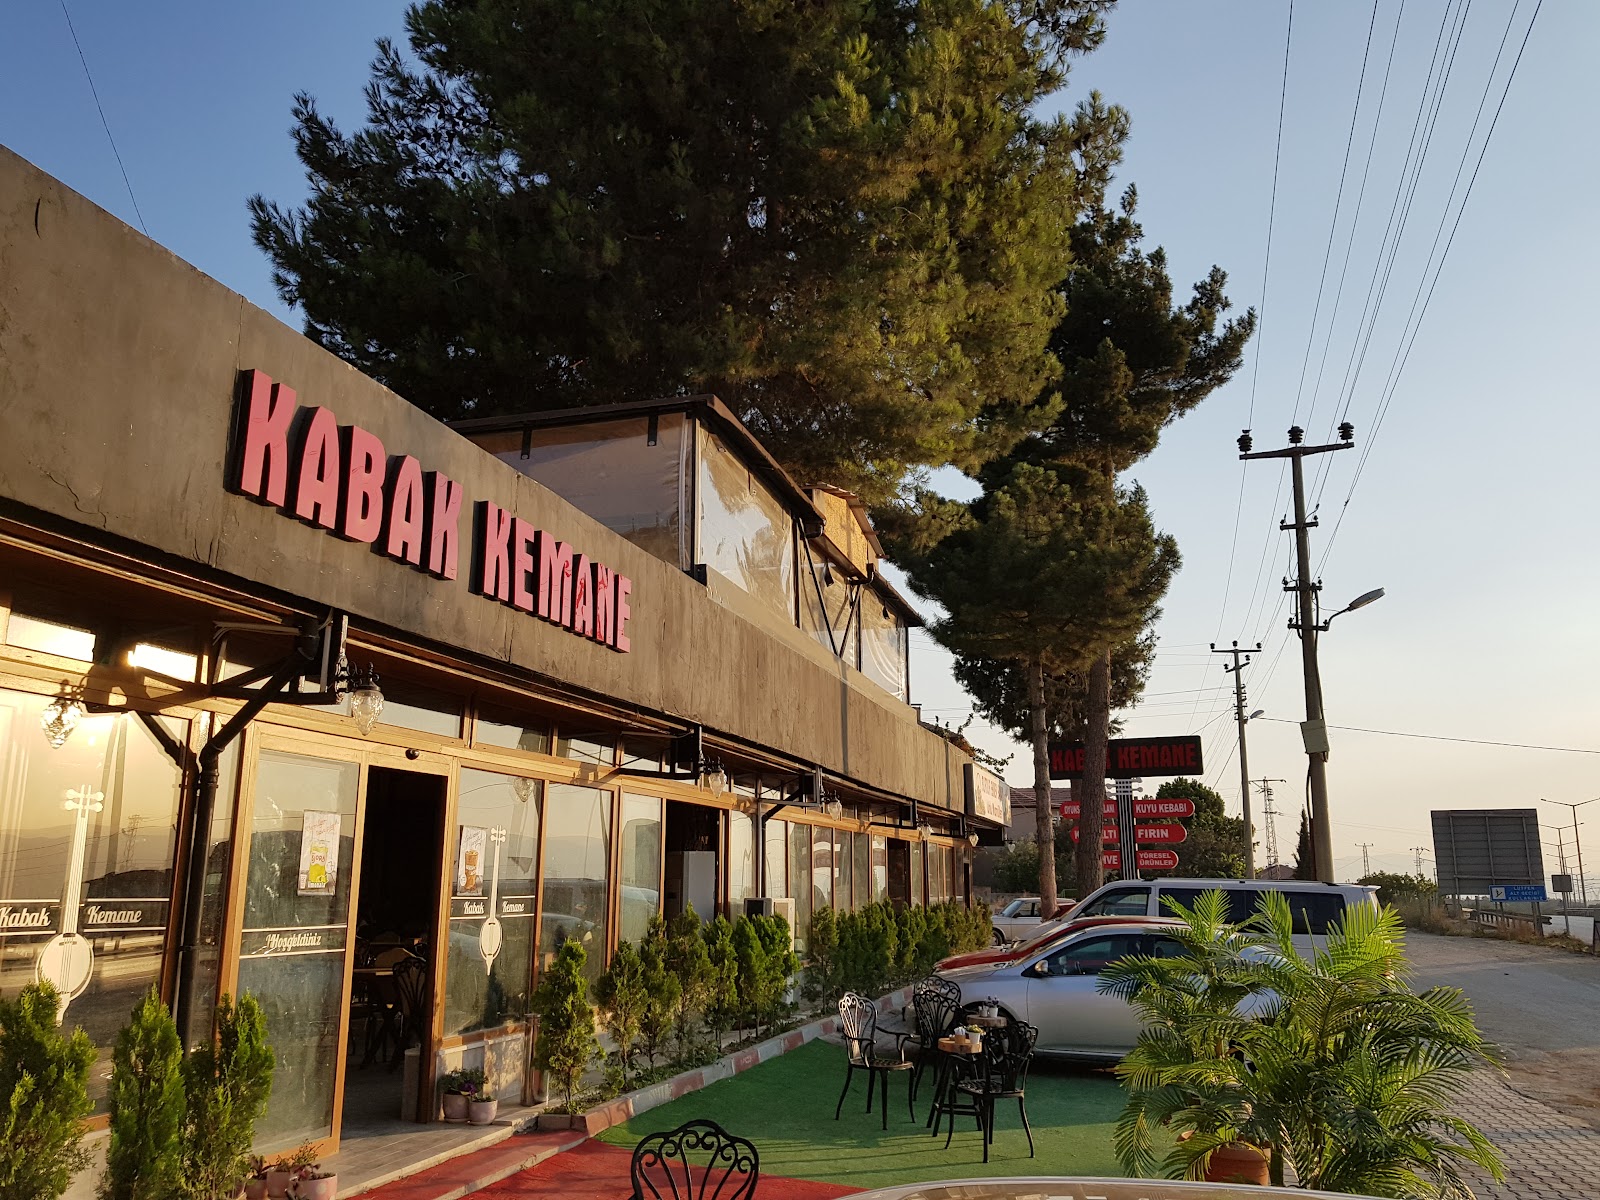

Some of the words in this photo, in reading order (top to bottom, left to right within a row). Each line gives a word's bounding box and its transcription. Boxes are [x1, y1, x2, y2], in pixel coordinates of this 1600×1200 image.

[239, 369, 463, 581] KABAK
[482, 500, 632, 653] KEMANE
[1118, 744, 1197, 769] KEMANE
[1135, 803, 1157, 814] KUYU
[1158, 802, 1187, 813] KEBABI
[1137, 828, 1169, 839] FIRIN
[0, 907, 51, 927] Kabak
[87, 905, 142, 924] Kemane
[463, 901, 485, 914] Kabak
[502, 901, 525, 913] Kemane
